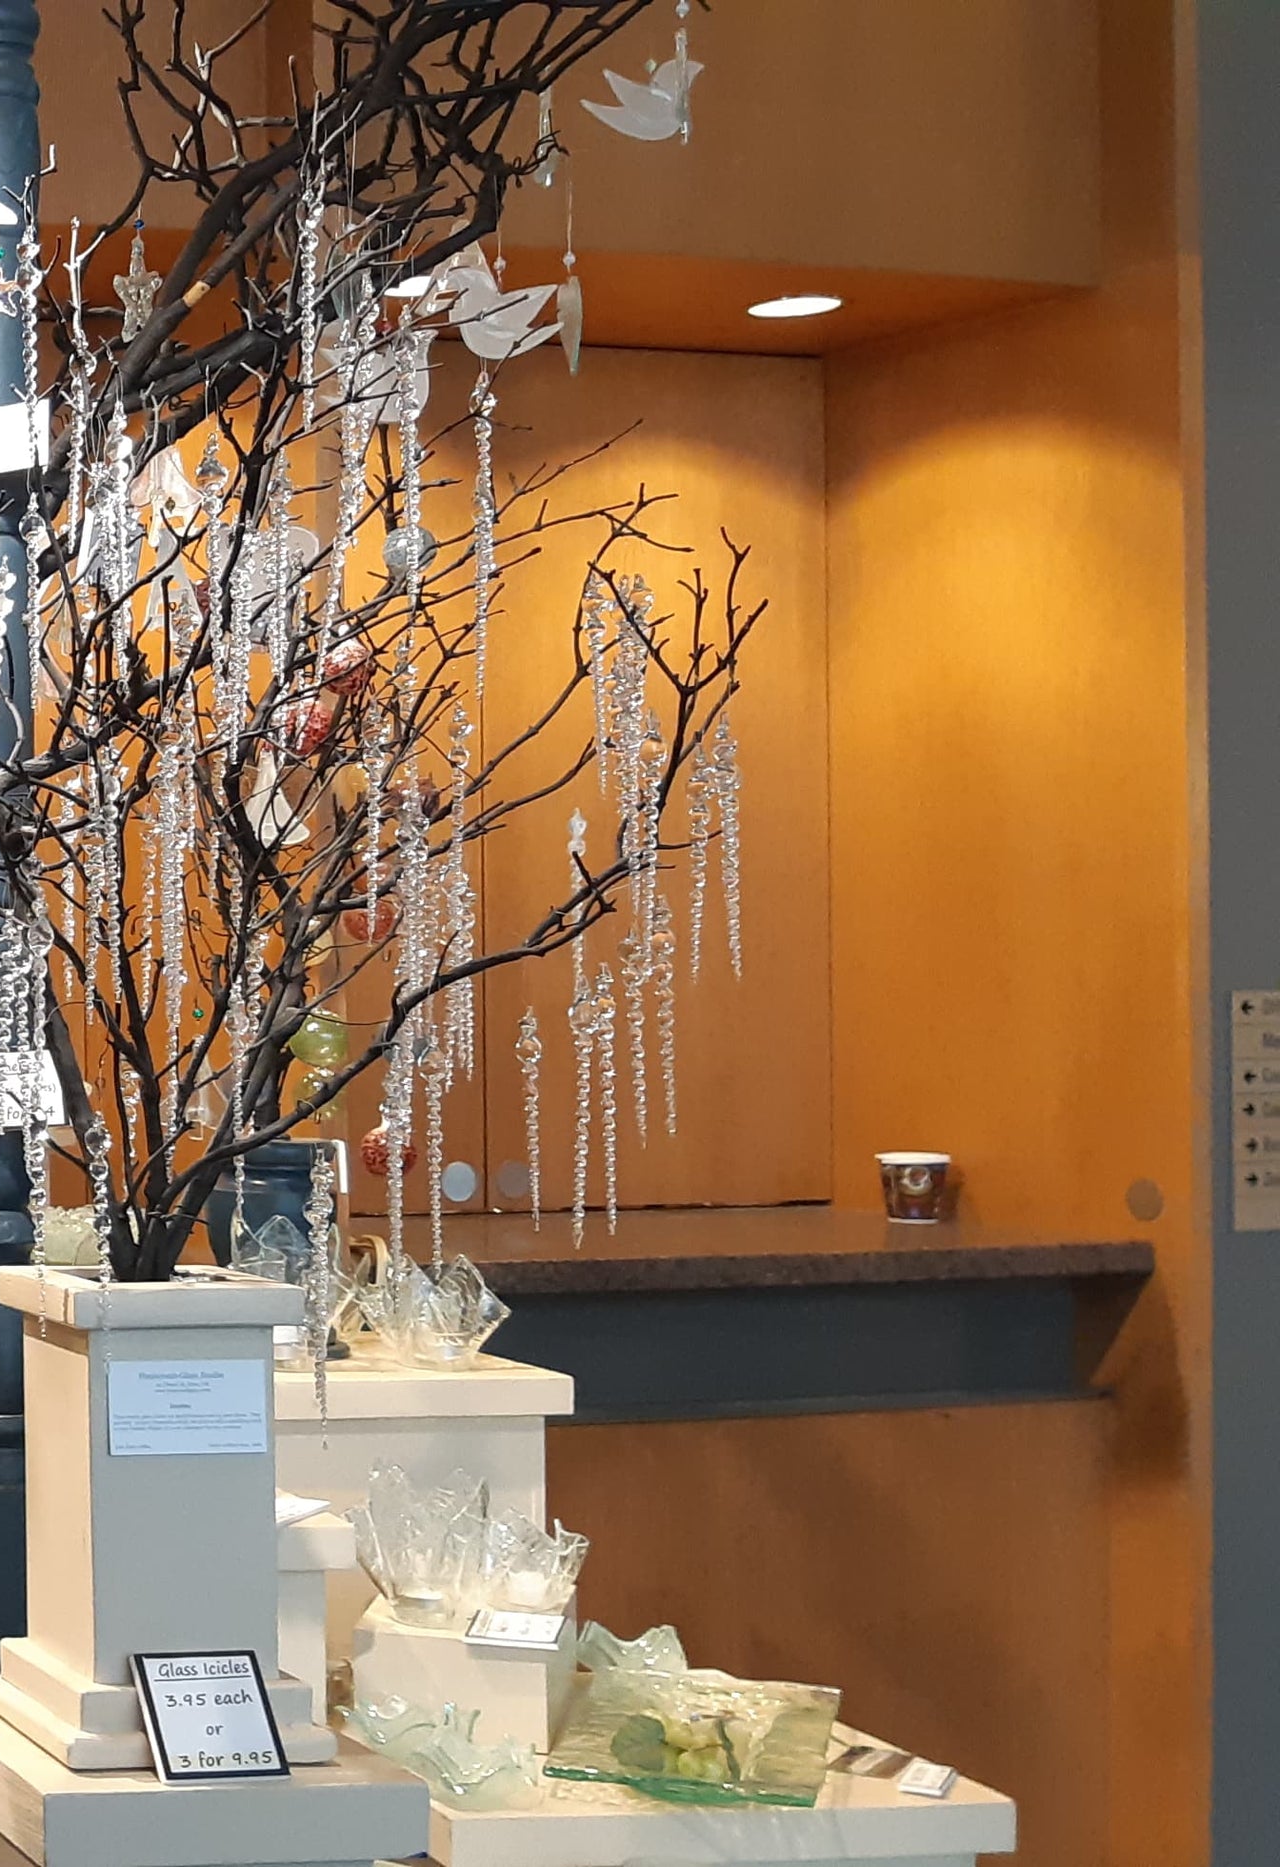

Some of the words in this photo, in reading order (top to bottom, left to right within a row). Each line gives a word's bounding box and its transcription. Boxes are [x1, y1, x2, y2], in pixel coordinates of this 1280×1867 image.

[158, 1663, 198, 1678] Glass
[203, 1659, 250, 1676] Icicles
[164, 1693, 207, 1707] 3.95
[214, 1689, 254, 1706] each
[205, 1724, 225, 1736] or
[178, 1755, 192, 1769] 3
[198, 1751, 225, 1768] for
[231, 1750, 274, 1766] 9.95
